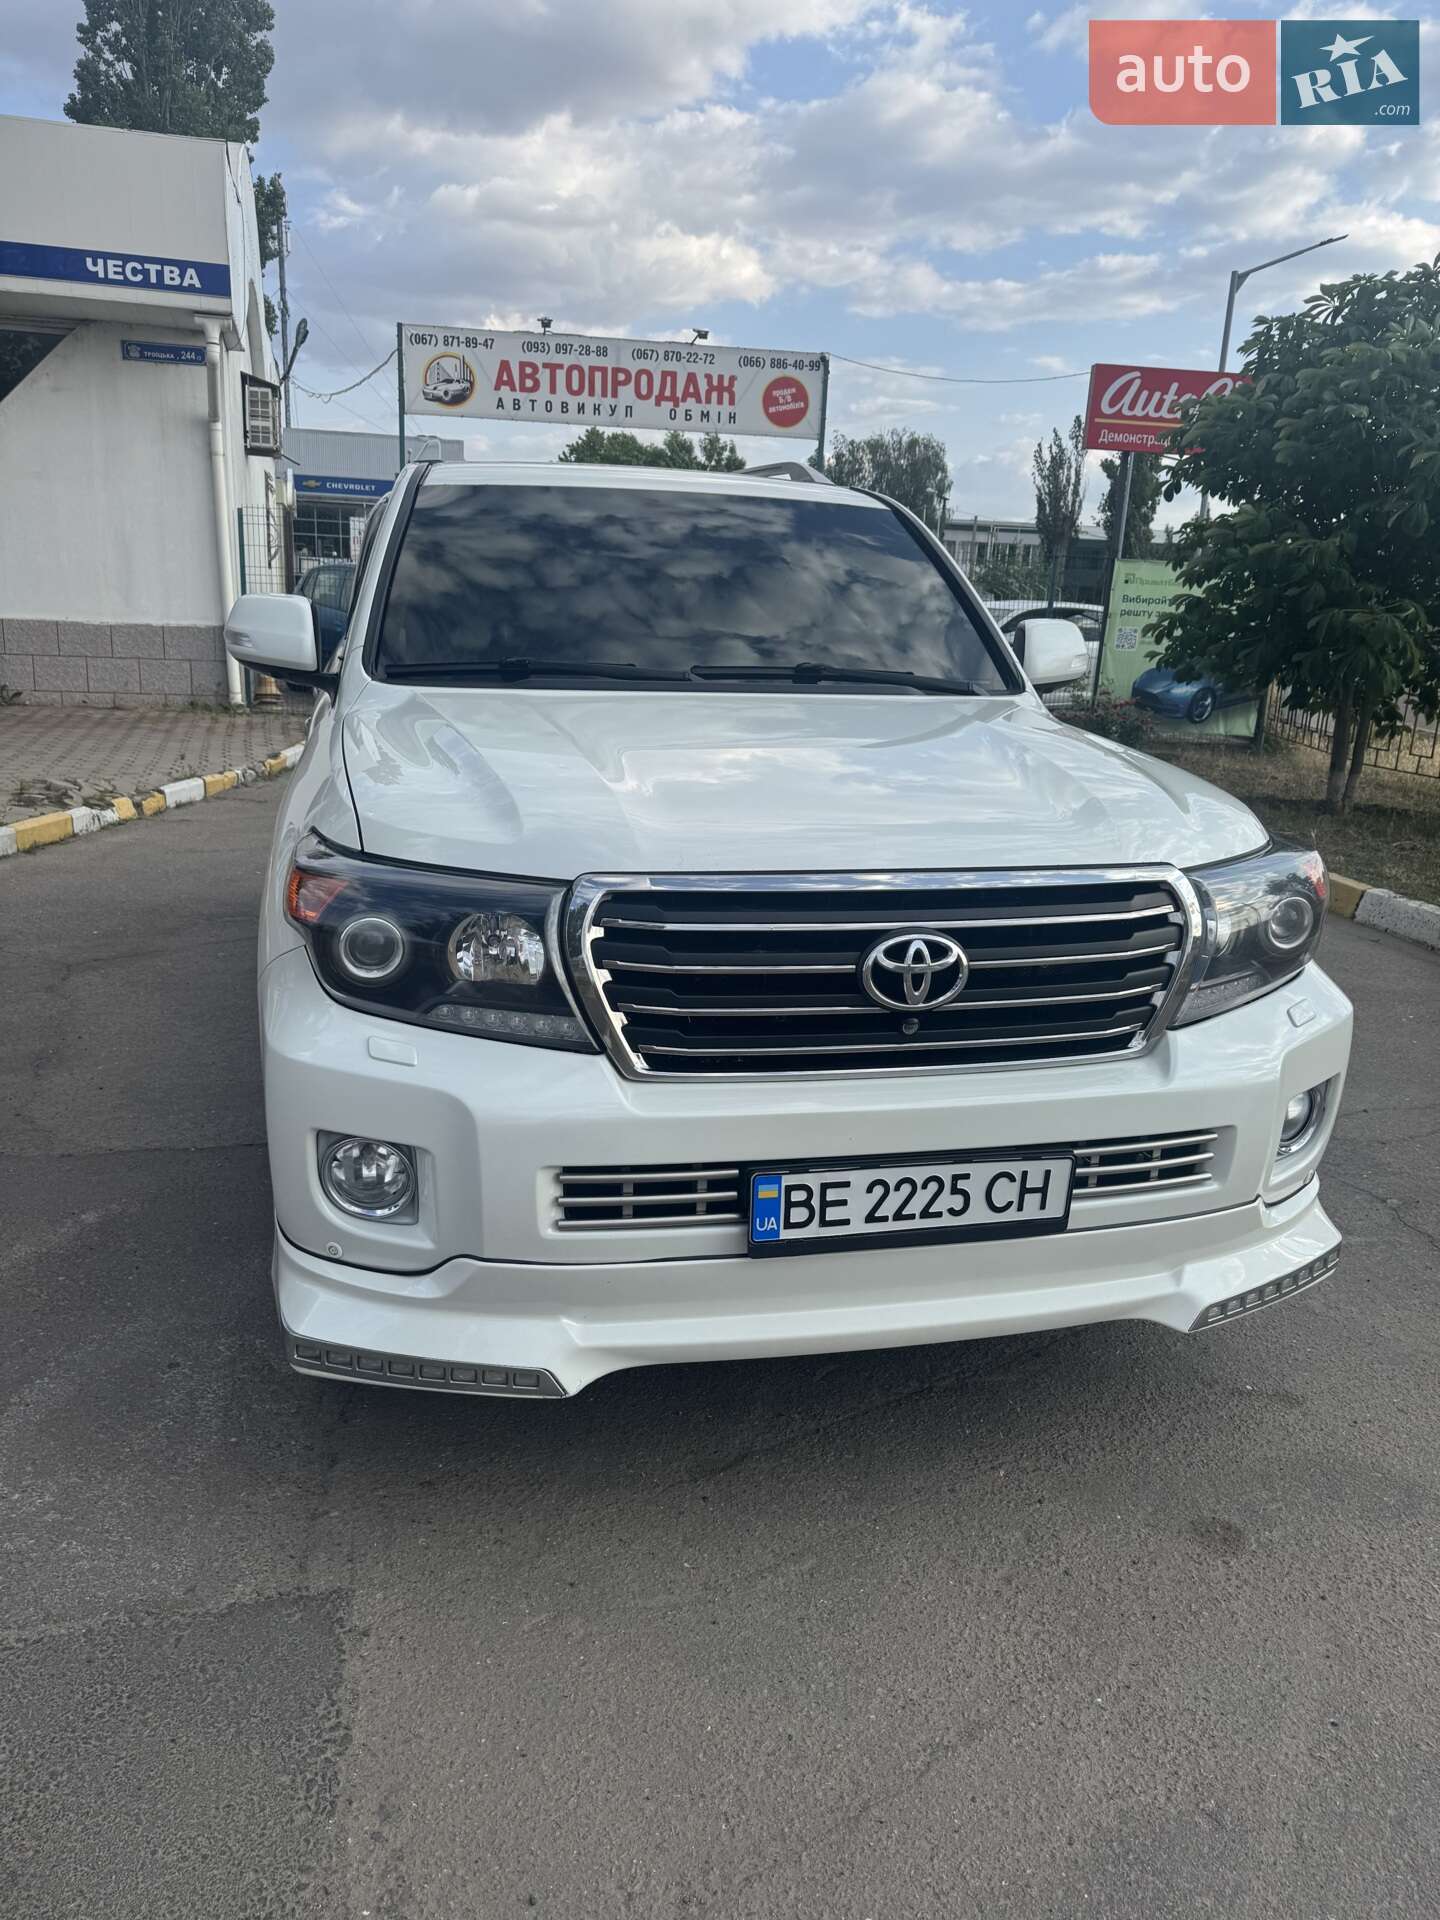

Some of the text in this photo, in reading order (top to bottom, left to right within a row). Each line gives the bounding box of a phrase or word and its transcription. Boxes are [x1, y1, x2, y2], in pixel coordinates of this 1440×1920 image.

[85, 256, 202, 289] ЧЕСТВА
[409, 333, 821, 372] (067) 871-89-47 (093) 097-28-88 (067) 870-22-72 (066) 886-40-99
[494, 359, 738, 408] АВТОПРОДАЖ
[496, 397, 737, 425] АВТОВИКУП ОБМІН
[326, 481, 376, 491] CHEVROLET
[1120, 608, 1153, 619] решту
[783, 1169, 1051, 1230] BE 2225 CH
[756, 1217, 777, 1231] UA
